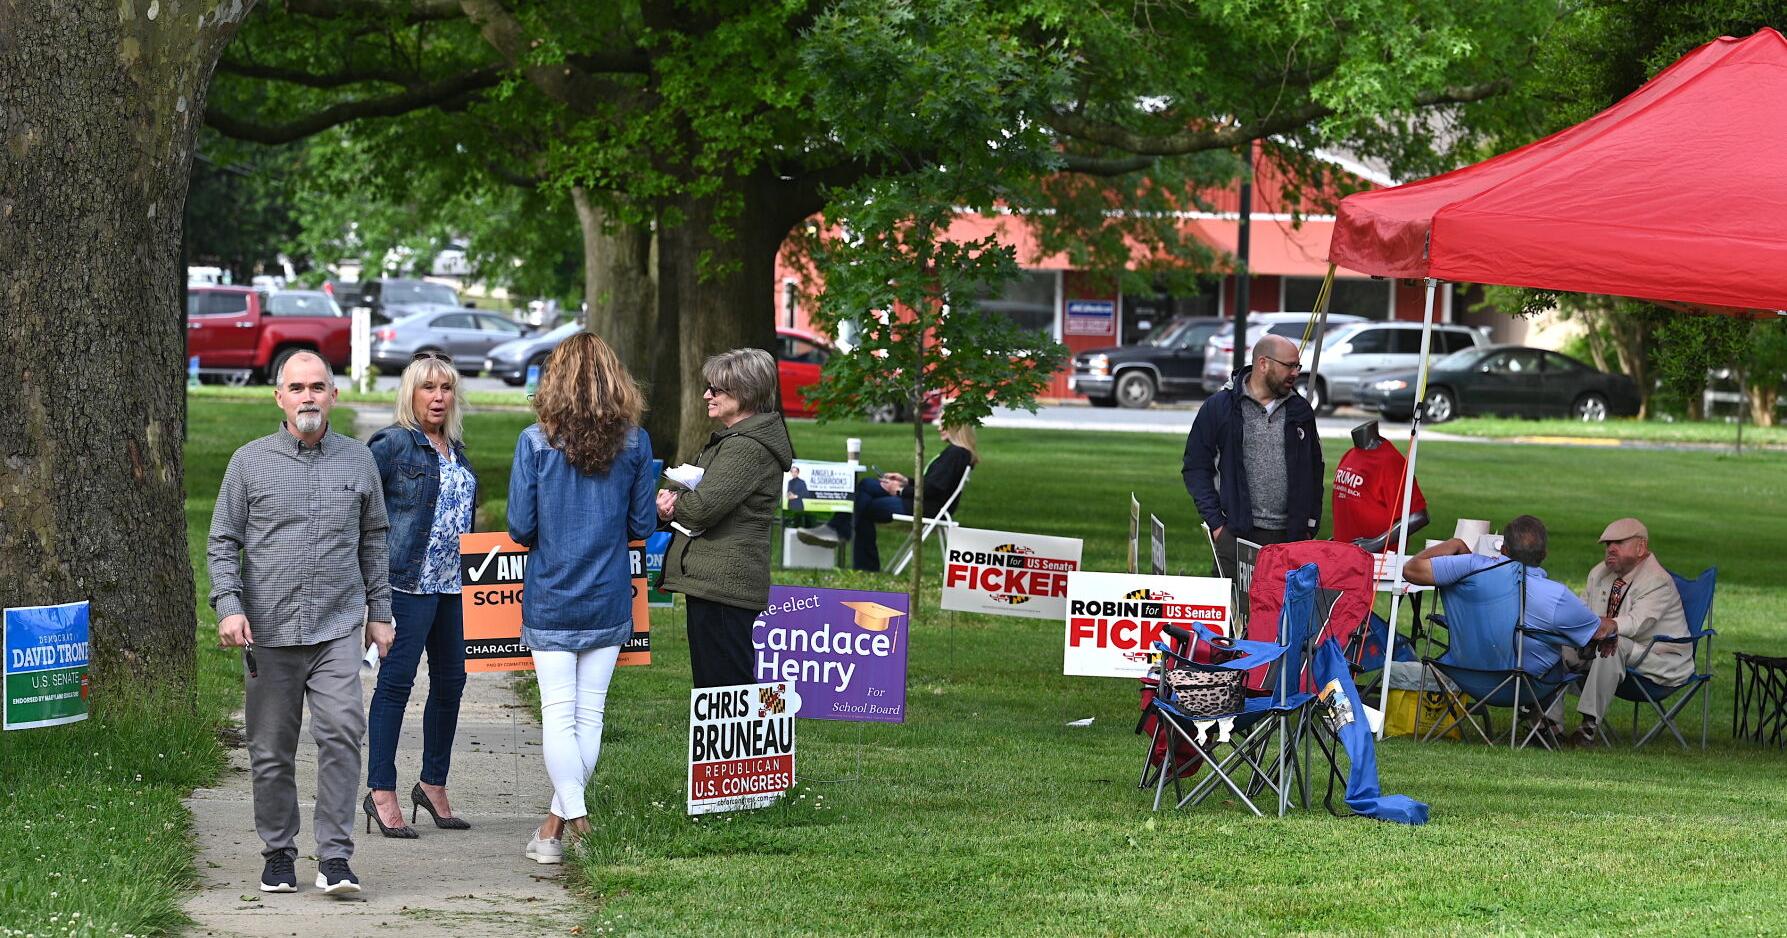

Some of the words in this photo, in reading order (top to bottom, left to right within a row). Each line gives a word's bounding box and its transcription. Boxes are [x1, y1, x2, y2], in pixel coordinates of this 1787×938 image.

[1335, 469, 1364, 488] RUMP
[949, 550, 1005, 567] ROBIN
[1009, 557, 1022, 566] for
[1027, 558, 1041, 569] US
[1042, 560, 1074, 571] Senate
[947, 564, 1068, 598] FICKER
[1071, 600, 1139, 617] ROBIN
[1145, 605, 1159, 615] for
[1167, 606, 1182, 617] US
[1185, 606, 1222, 619] Senate
[752, 619, 890, 657] Candace
[1070, 618, 1224, 653] FICK
[13, 645, 56, 668] DAVID
[31, 675, 50, 689] U.S.
[53, 671, 79, 686] SENATE
[757, 651, 856, 693] Henry
[13, 696, 38, 704] ENDORSED
[867, 687, 885, 697] For
[694, 689, 750, 721] CHRIS
[832, 701, 867, 713] School
[869, 704, 901, 715] Board
[692, 717, 793, 762] BRUNEAU
[705, 758, 780, 778] REPUBLICAN
[695, 780, 719, 797] U.S.
[722, 772, 789, 795] CONGRESS
